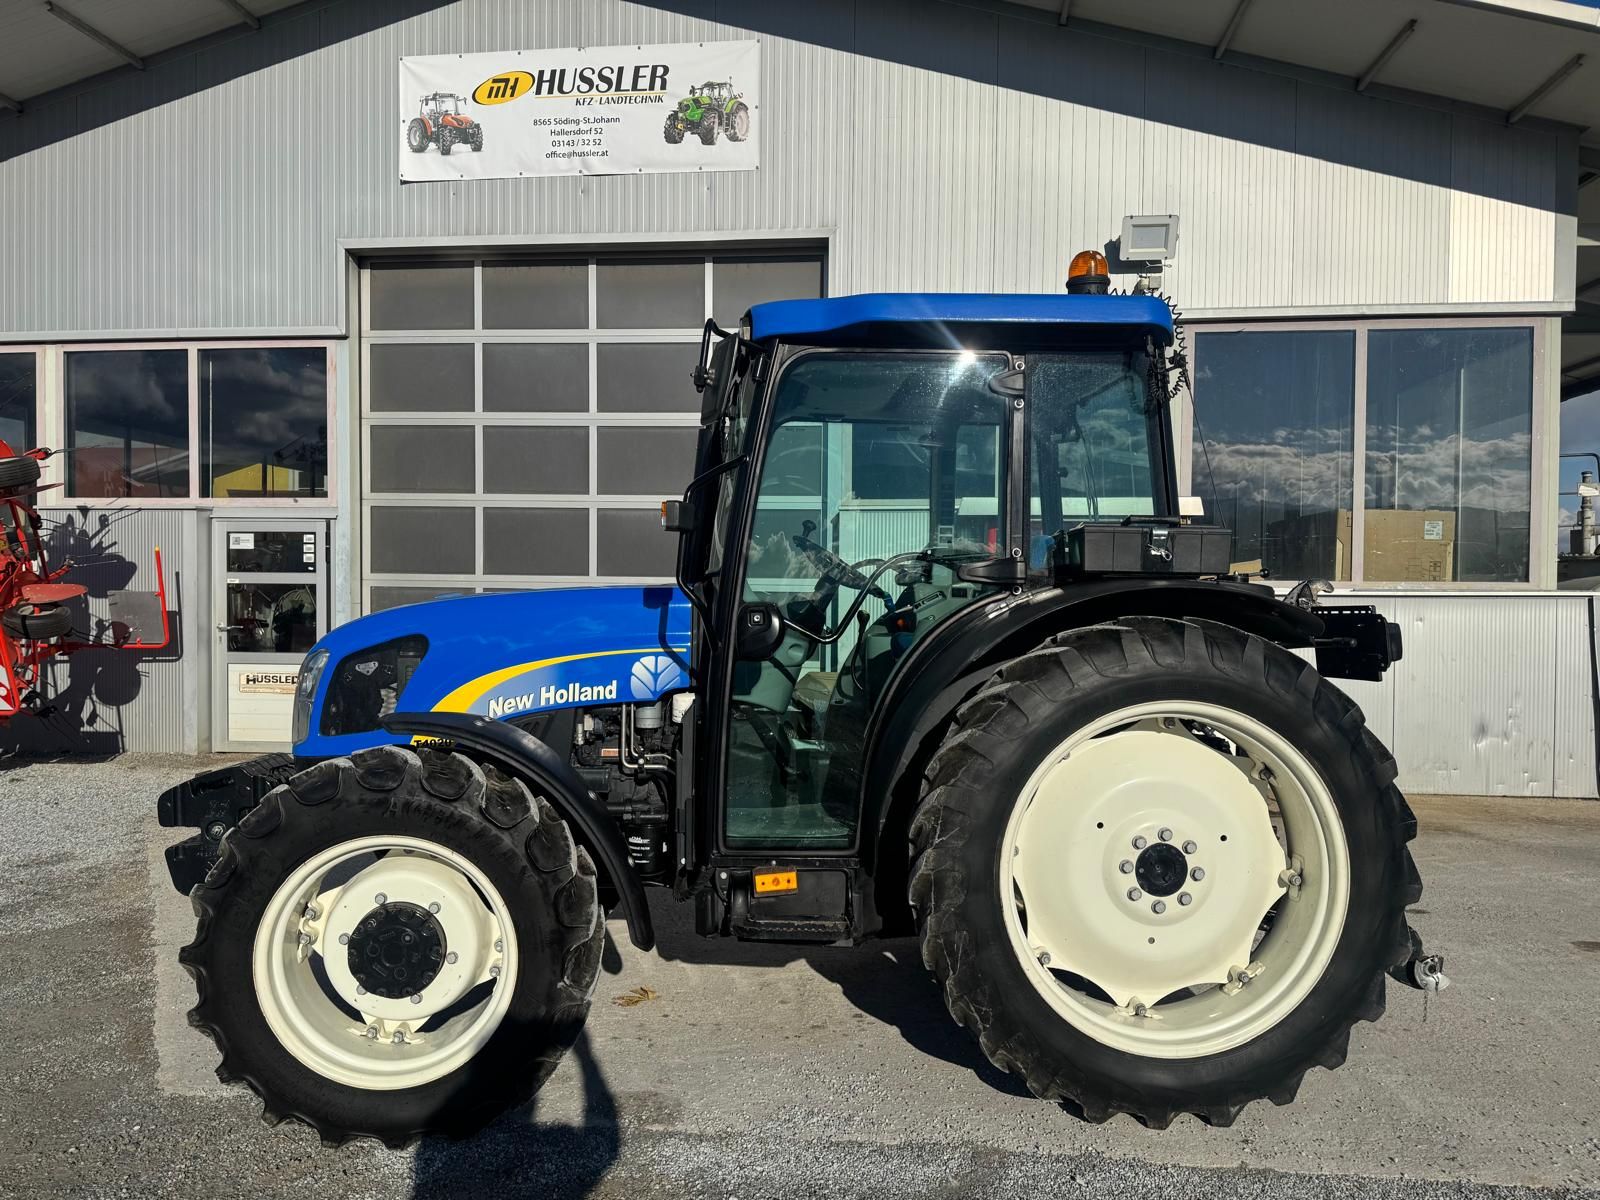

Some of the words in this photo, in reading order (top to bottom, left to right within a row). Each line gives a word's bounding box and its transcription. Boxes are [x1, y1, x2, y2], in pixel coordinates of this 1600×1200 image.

[535, 64, 670, 96] HUSSLER
[533, 118, 552, 126] 8565
[550, 127, 592, 136] Hallersdorf
[593, 127, 603, 135] 52
[551, 139, 575, 147] 03143
[581, 138, 591, 146] 32
[592, 138, 602, 146] 52
[545, 149, 609, 158] office@hussler.at
[488, 692, 534, 718] New
[540, 680, 618, 706] Holland
